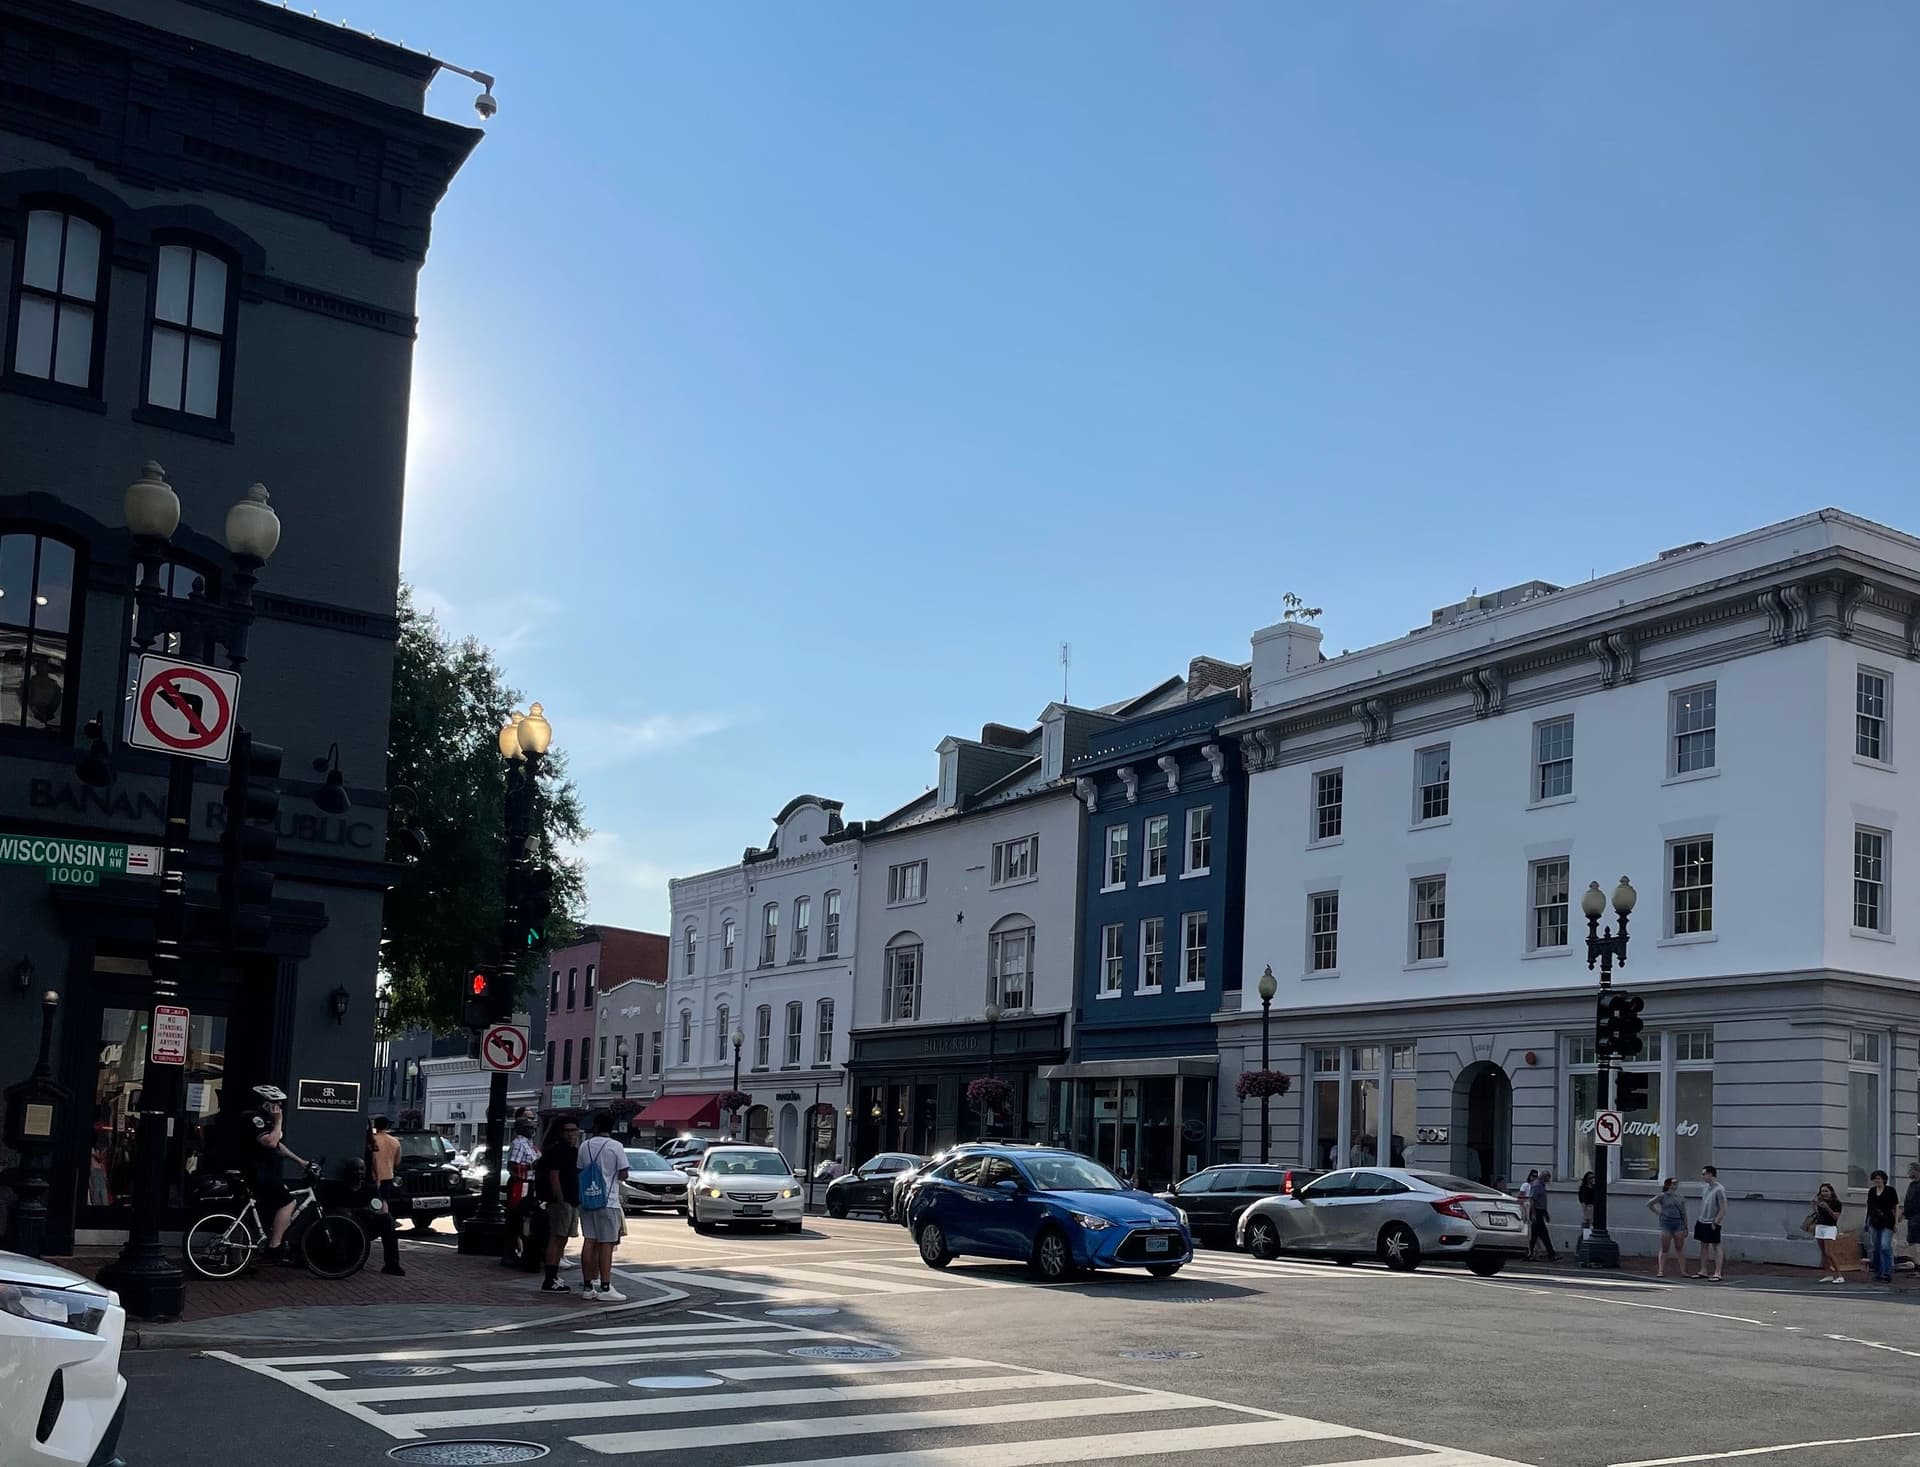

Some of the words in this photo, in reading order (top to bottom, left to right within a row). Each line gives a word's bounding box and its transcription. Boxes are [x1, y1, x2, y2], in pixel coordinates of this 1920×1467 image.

[29, 777, 167, 821] BANAN
[204, 801, 374, 848] RUBLIC
[0, 838, 105, 867] WISCONSIN
[109, 847, 124, 858] AVE
[109, 858, 122, 869] NW
[51, 867, 94, 884] 1000
